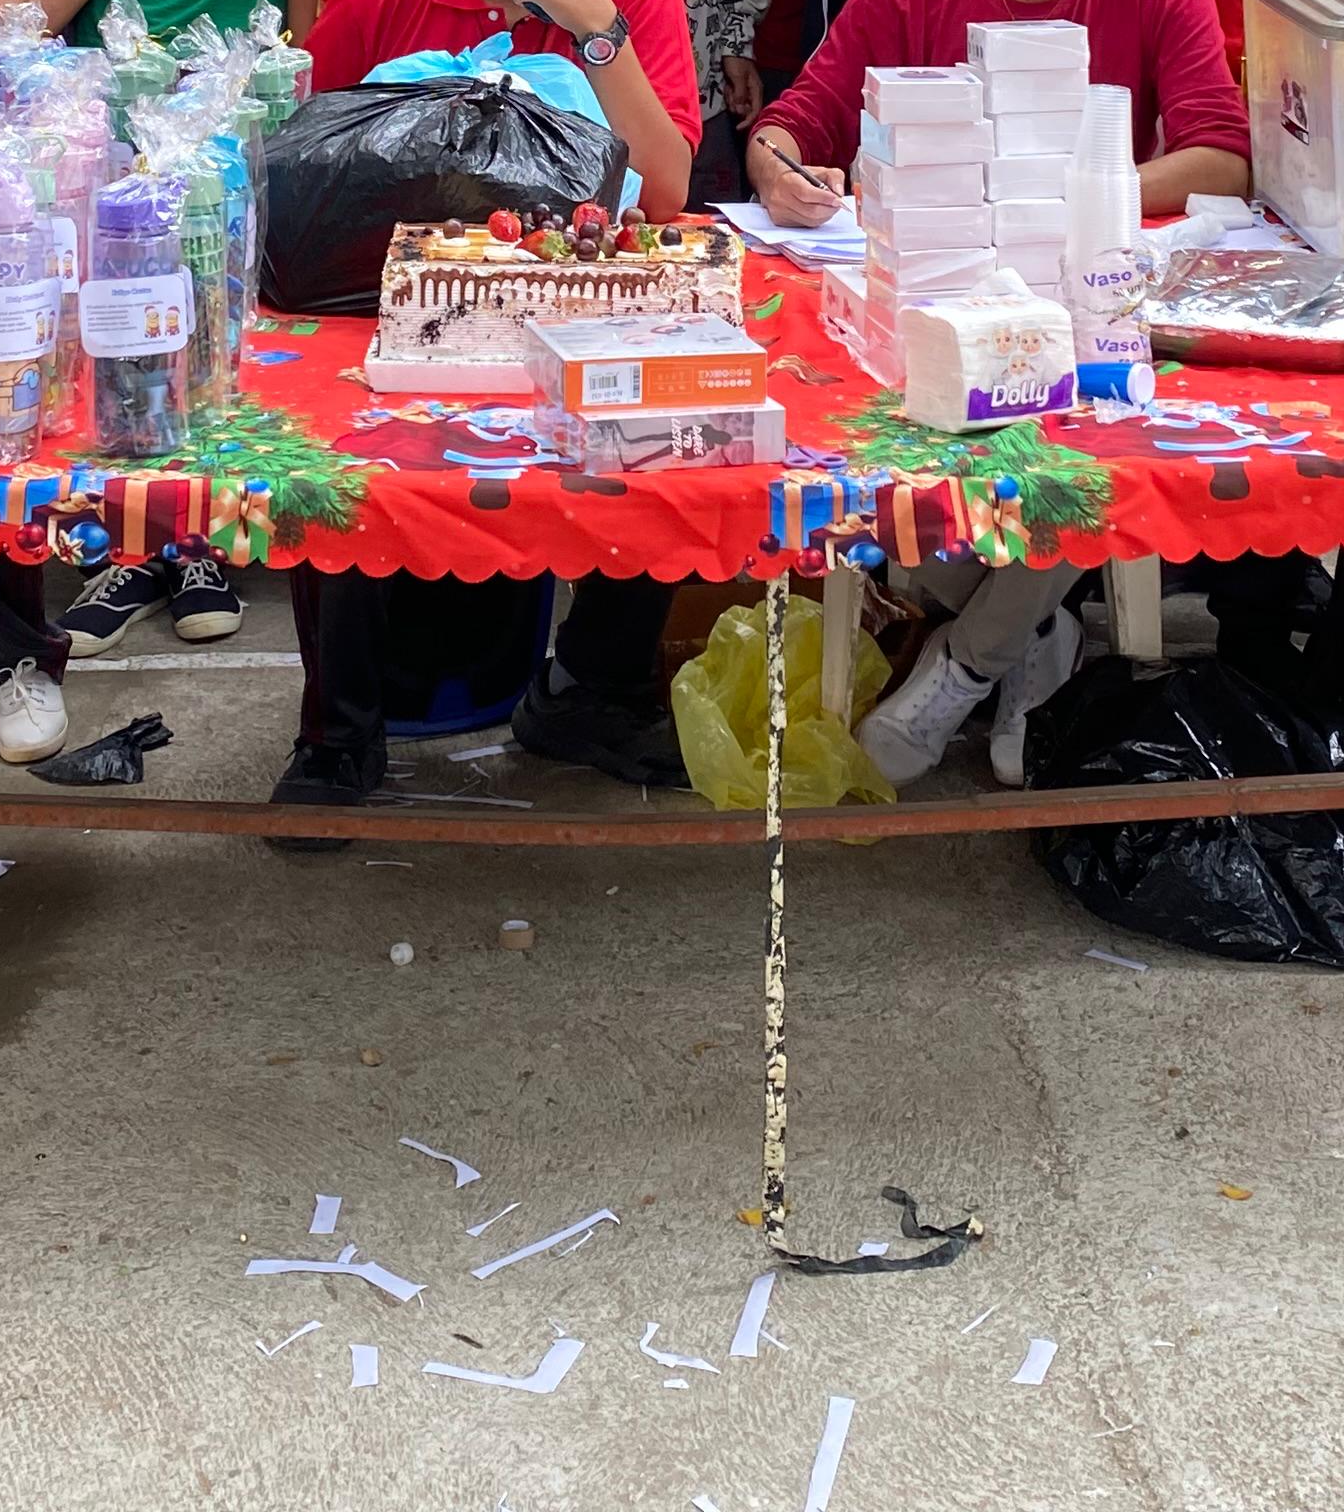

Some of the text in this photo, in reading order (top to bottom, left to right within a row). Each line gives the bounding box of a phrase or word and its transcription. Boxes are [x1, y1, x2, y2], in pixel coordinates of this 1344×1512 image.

[1083, 271, 1132, 287] Vaso
[1095, 337, 1139, 353] Vaso
[991, 380, 1050, 408] Dolly
[692, 424, 704, 457] DARE
